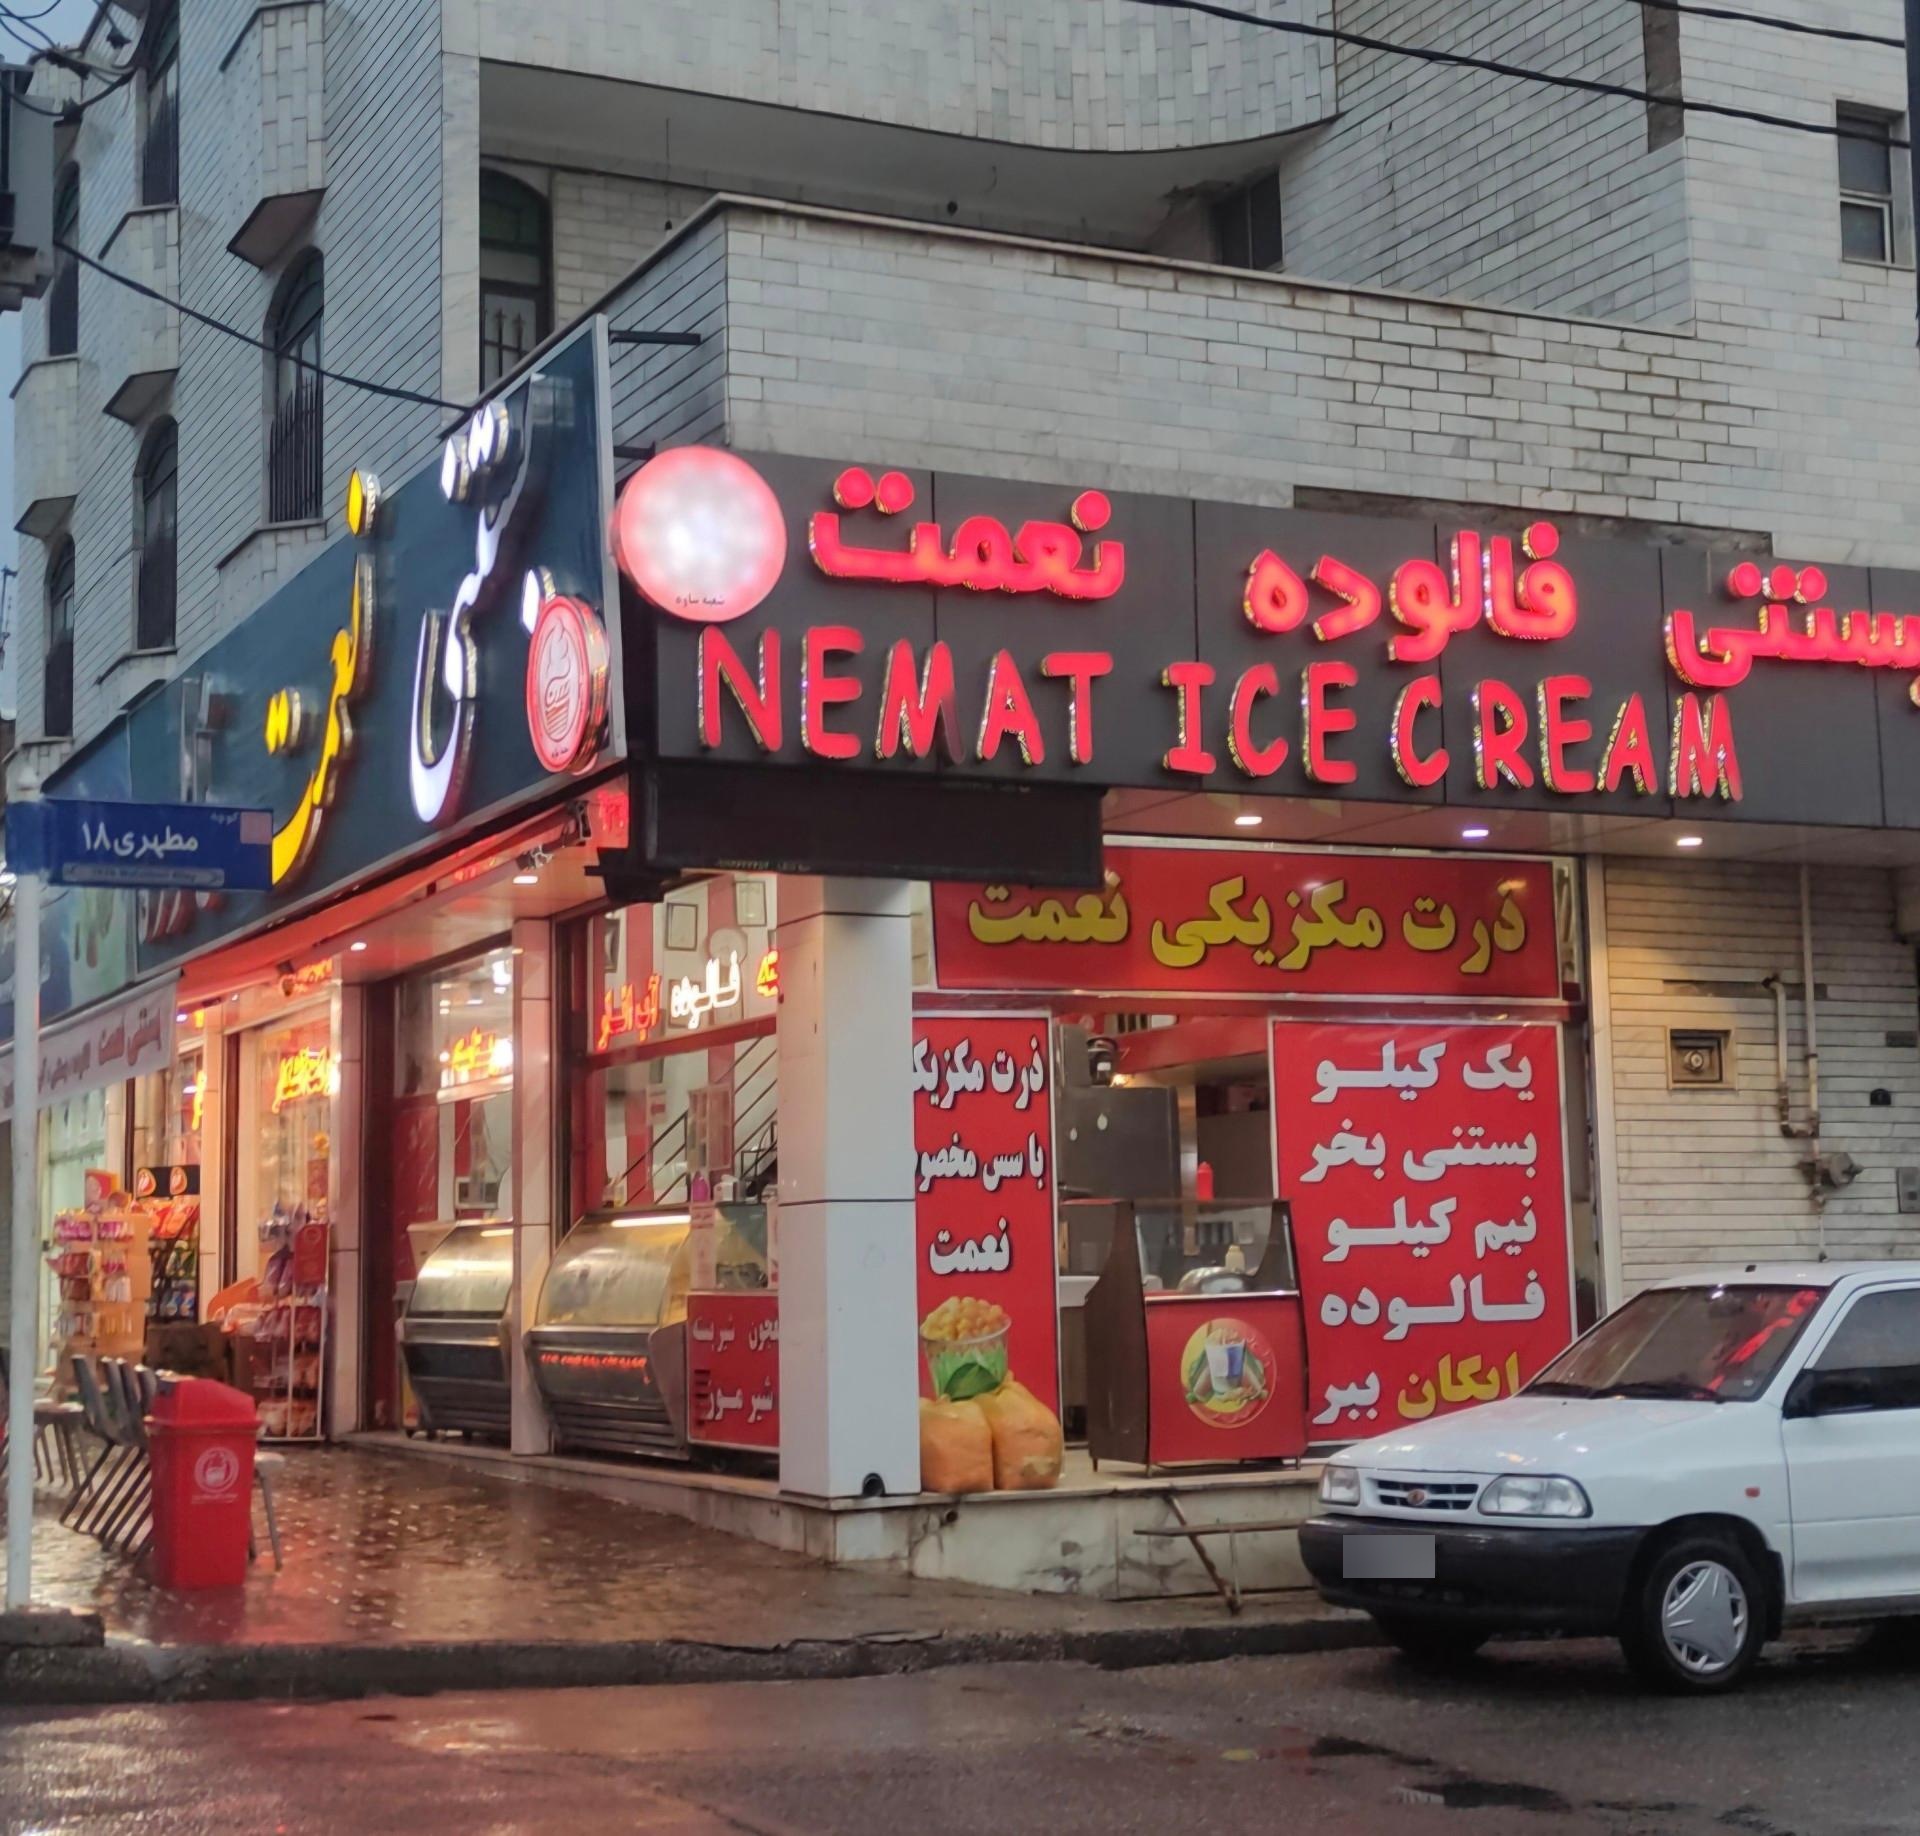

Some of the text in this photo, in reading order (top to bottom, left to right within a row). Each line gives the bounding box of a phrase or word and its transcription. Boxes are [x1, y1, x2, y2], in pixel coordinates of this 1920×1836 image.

[808, 466, 1920, 708] ستنی فالوده نعمت
[698, 624, 1743, 802] NEMAT ICE CREAM
[968, 873, 1526, 973] ذرت مکزیکی نعمت
[913, 1035, 1044, 1109] ذرت مکزیک
[1311, 1040, 1533, 1103] یک کیلو
[914, 1132, 1044, 1192] با سس مخصو
[1299, 1119, 1538, 1182] بستنی بخر
[929, 1217, 1010, 1274] نعمت
[1322, 1196, 1537, 1262] نیم کیلو
[1320, 1269, 1546, 1340] فالوده
[1312, 1371, 1381, 1424] ببر
